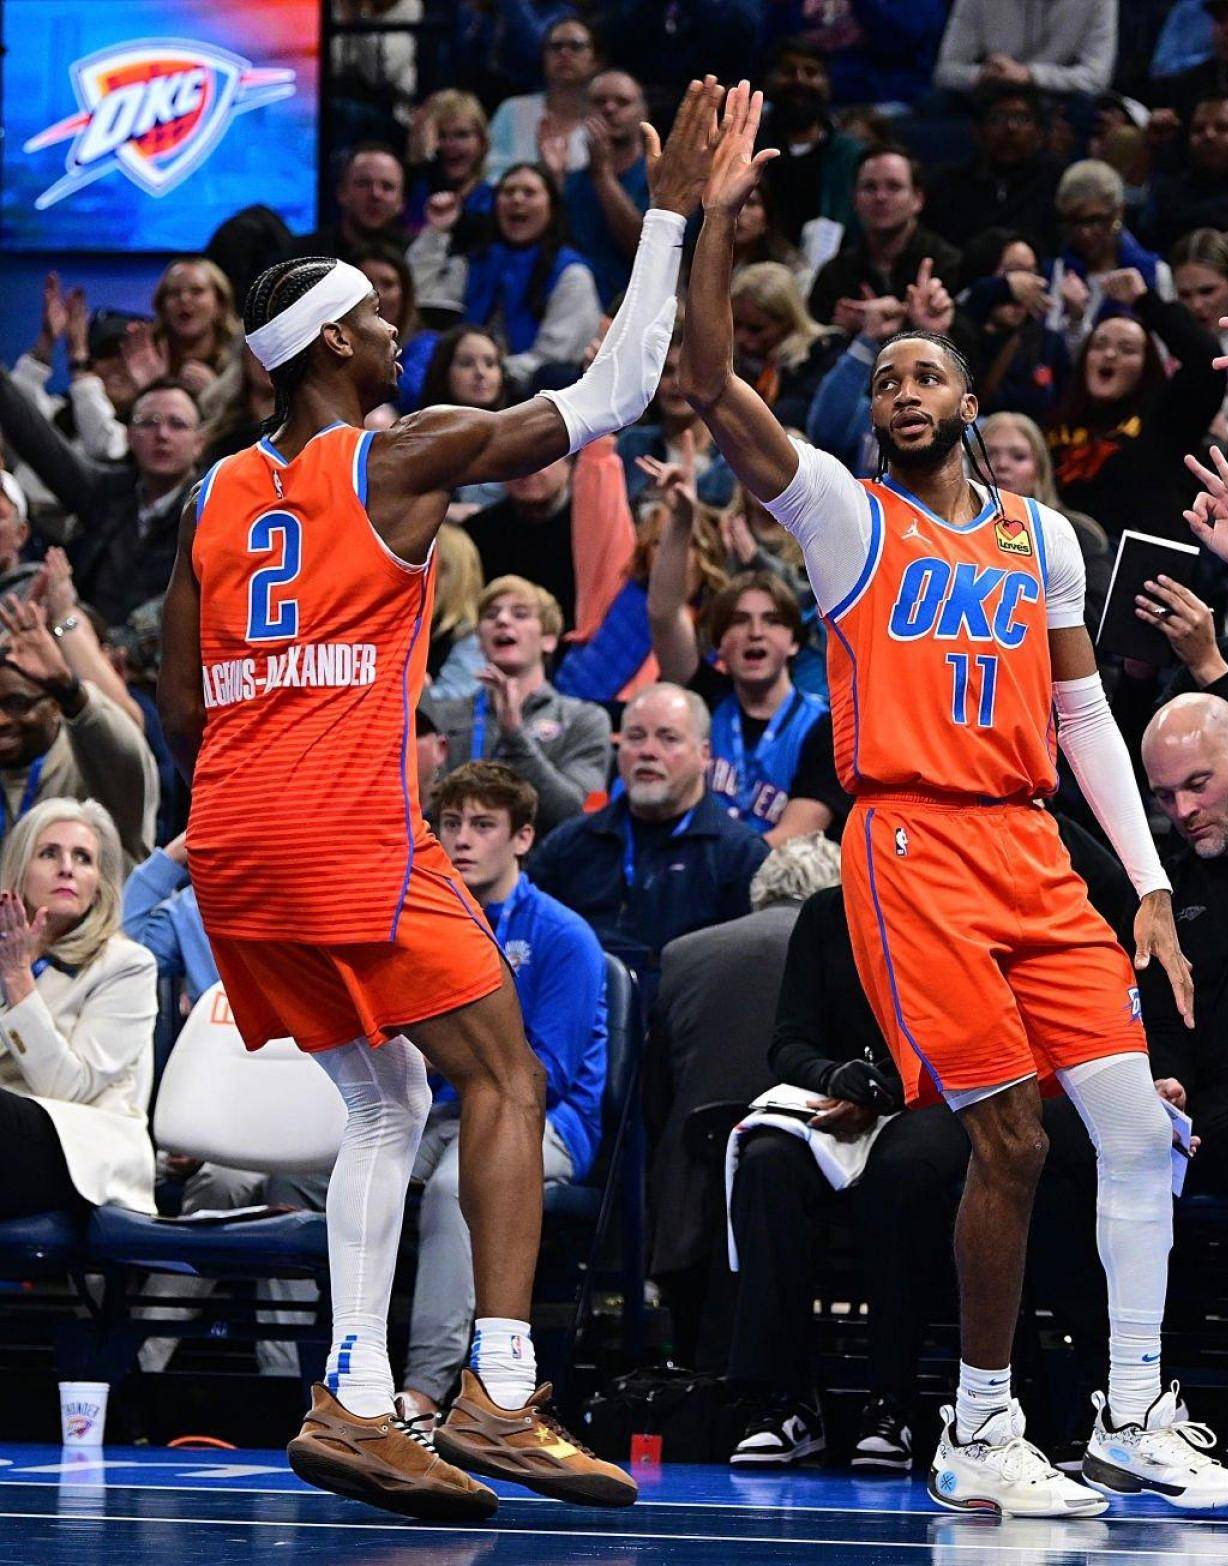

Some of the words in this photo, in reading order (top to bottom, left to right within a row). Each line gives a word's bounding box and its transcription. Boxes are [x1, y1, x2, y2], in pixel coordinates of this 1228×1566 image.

[77, 66, 206, 164] OKC
[244, 508, 302, 642] 2
[887, 556, 1040, 650] OKC
[945, 652, 998, 728] 11
